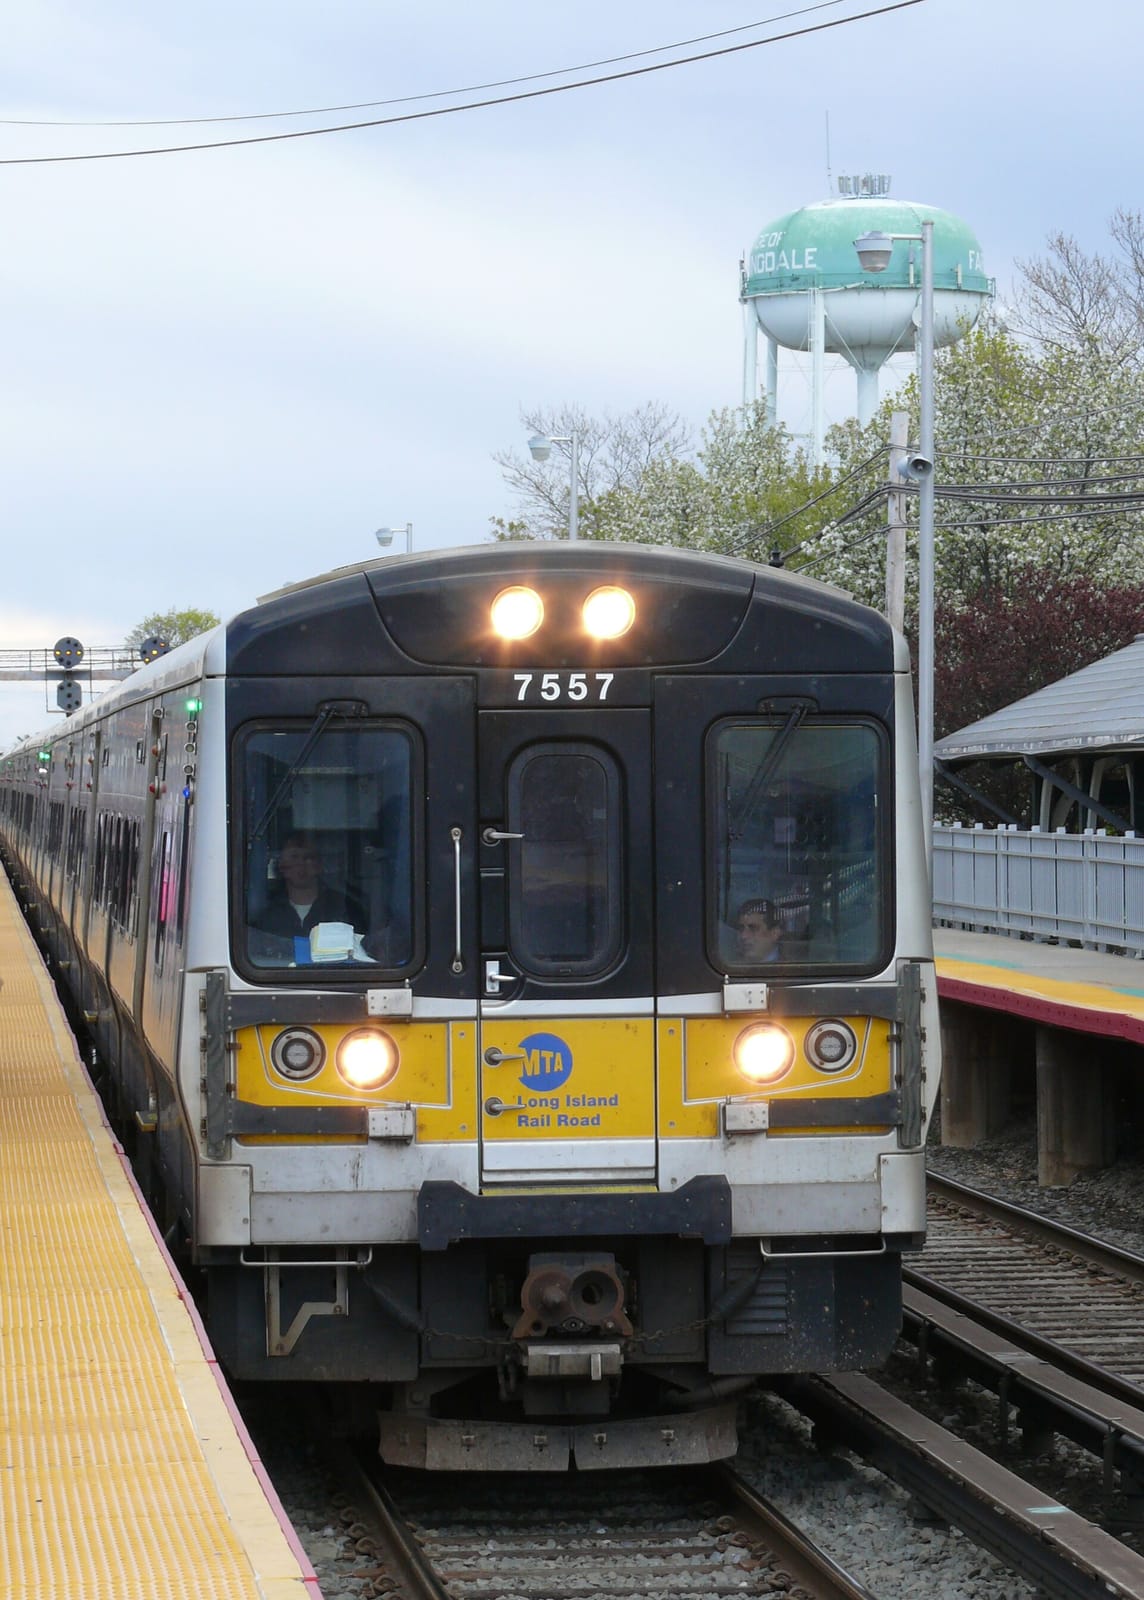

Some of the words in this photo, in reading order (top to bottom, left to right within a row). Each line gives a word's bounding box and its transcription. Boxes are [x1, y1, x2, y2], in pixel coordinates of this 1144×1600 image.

[513, 673, 614, 701] 7557
[520, 1047, 564, 1078] MTA
[517, 1095, 560, 1110] Long
[566, 1094, 619, 1107] Island
[517, 1115, 552, 1127] Rail
[557, 1114, 601, 1127] Road
